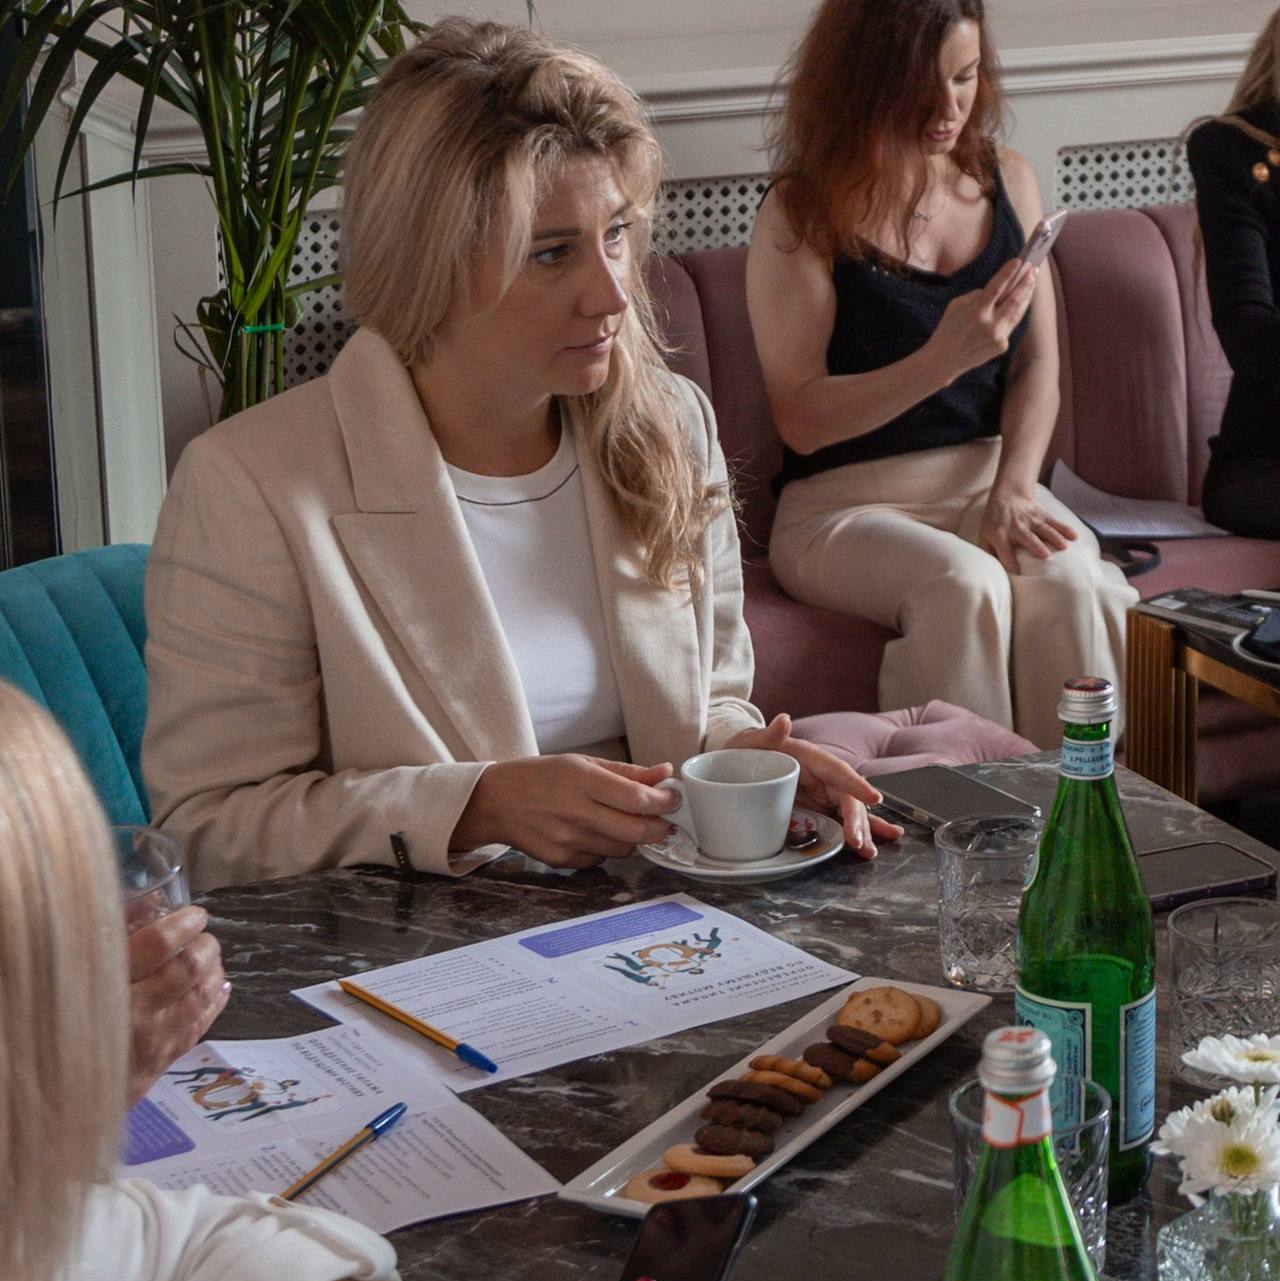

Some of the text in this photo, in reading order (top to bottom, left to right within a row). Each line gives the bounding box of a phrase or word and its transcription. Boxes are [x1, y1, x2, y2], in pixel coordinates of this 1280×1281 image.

[659, 959, 806, 1002] ПО ВЕДУЩЕМУ МОТИВУ
[670, 964, 816, 1007] ОПРЕДЕЛЕНИЕ ТИПАЖА
